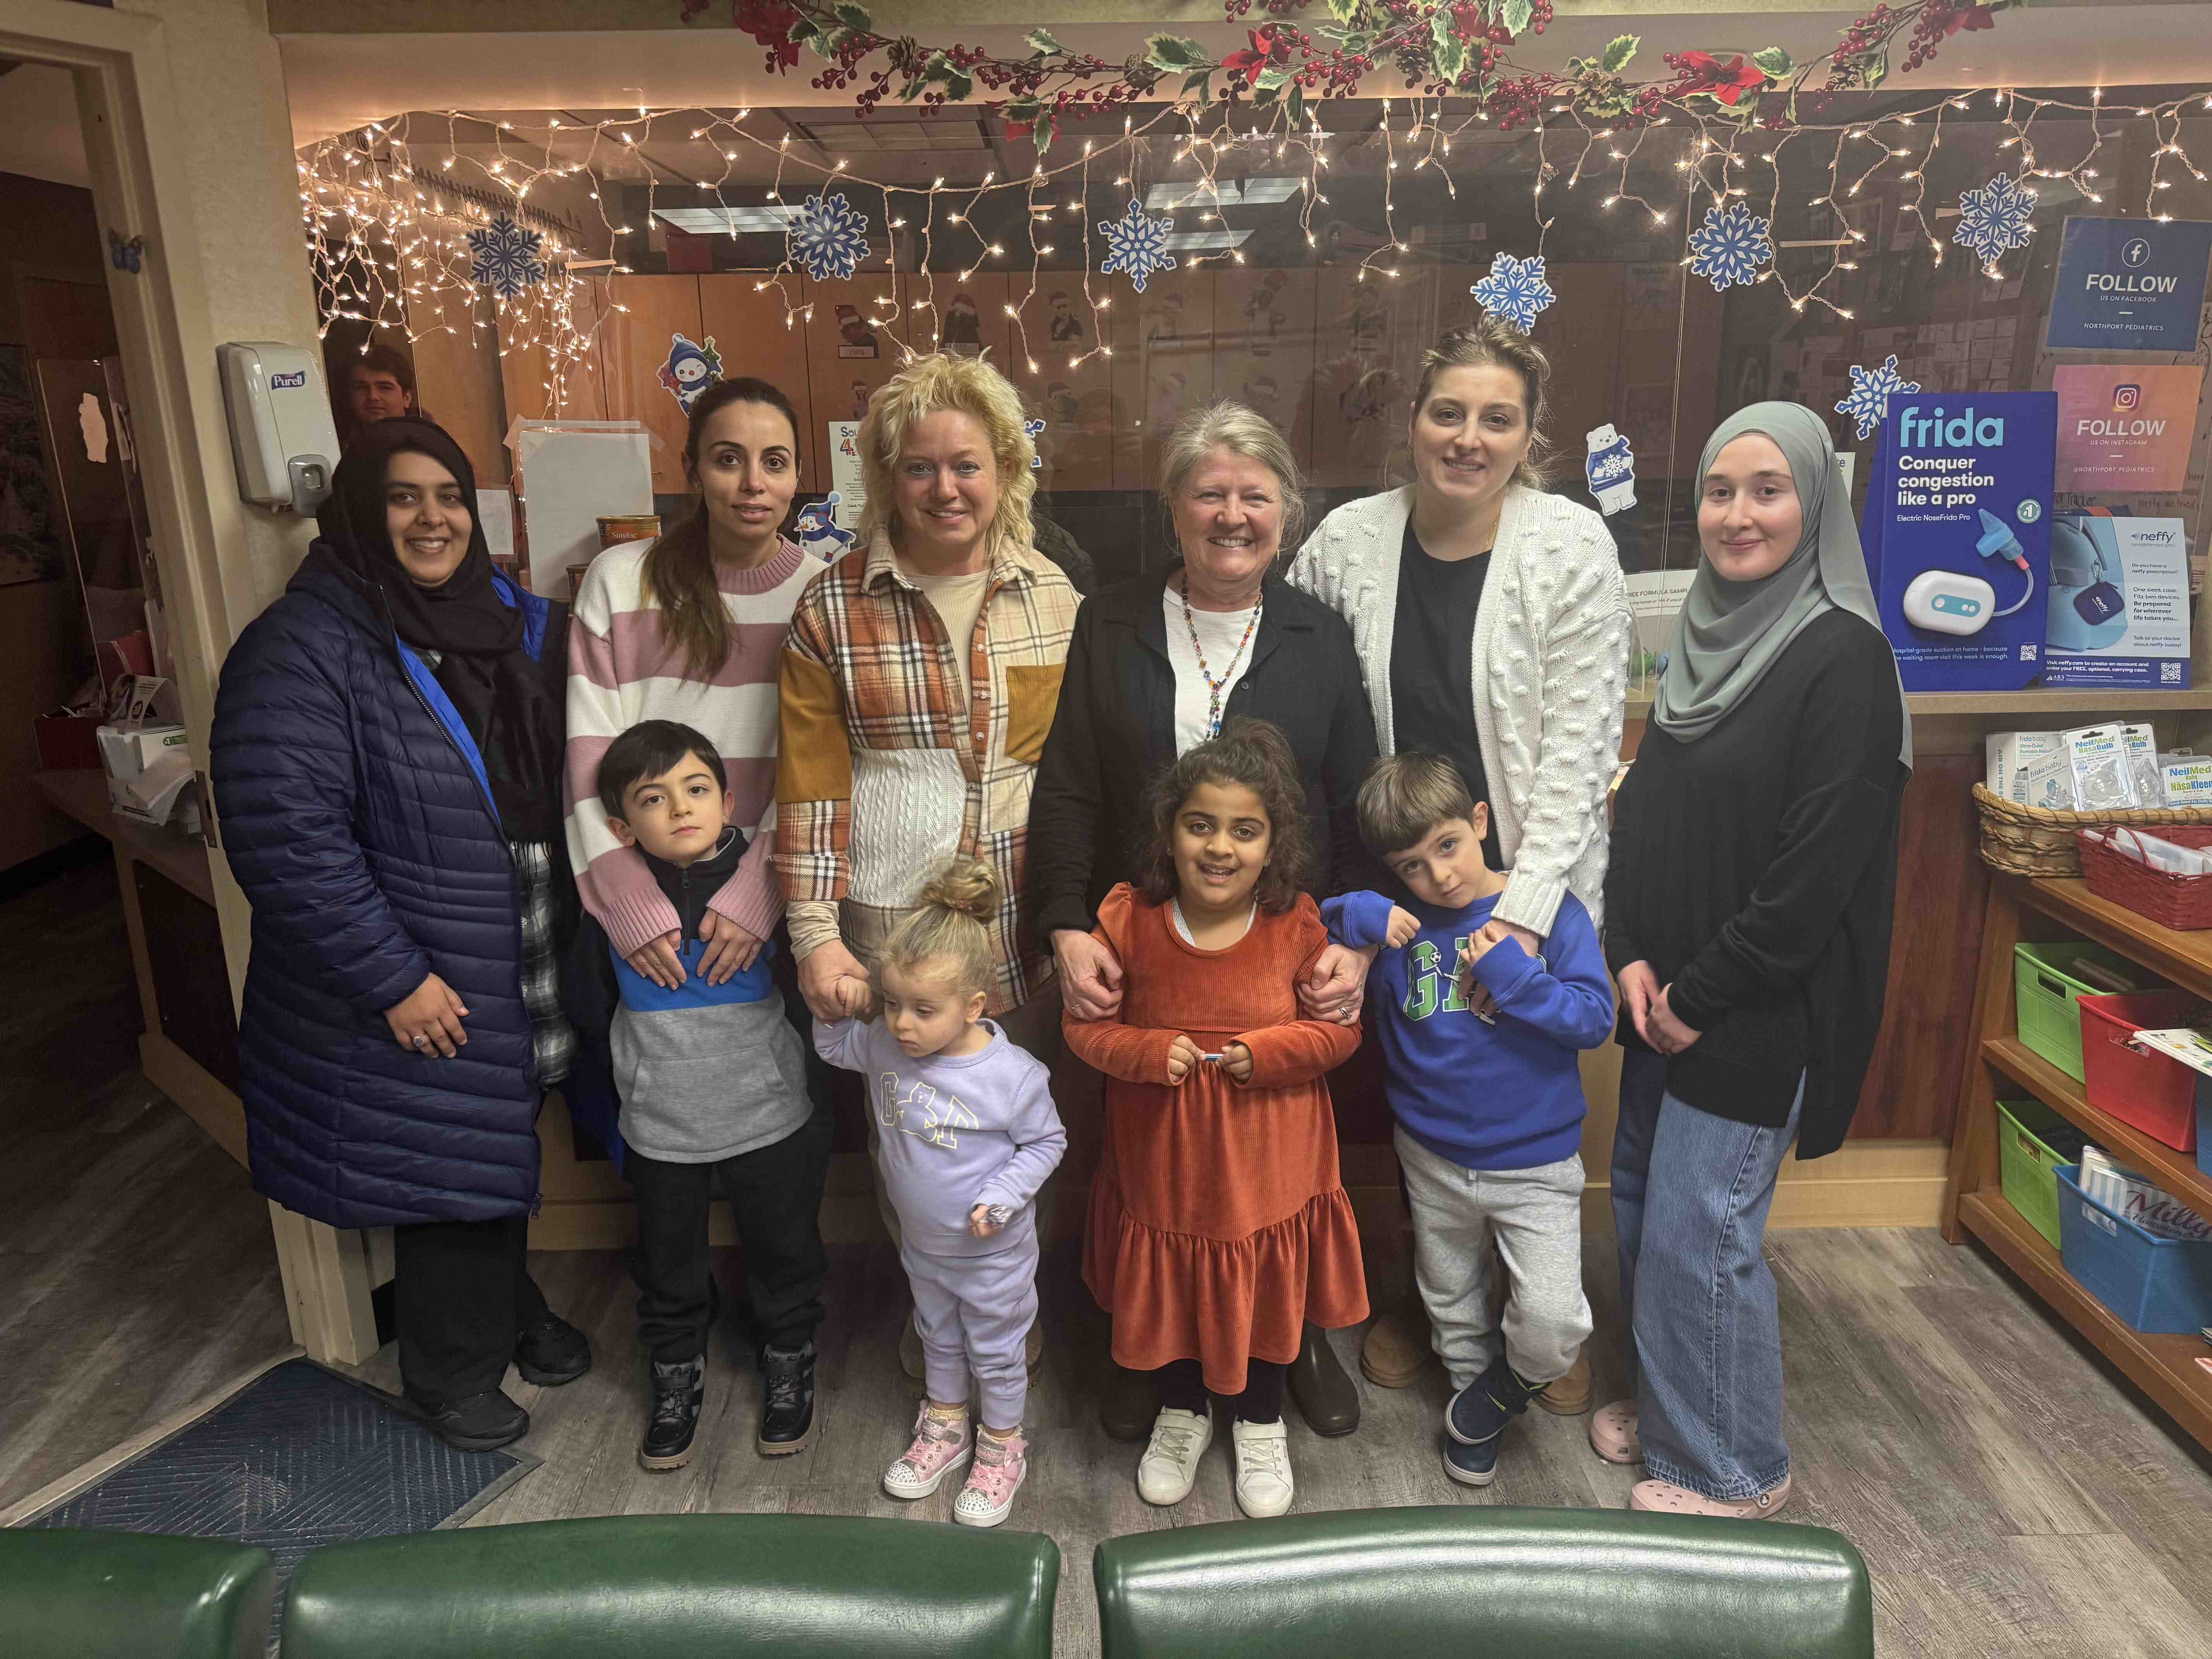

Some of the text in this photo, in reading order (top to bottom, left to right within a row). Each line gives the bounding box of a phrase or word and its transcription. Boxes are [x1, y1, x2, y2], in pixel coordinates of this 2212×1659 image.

[2086, 274, 2178, 292] FOLLOW
[273, 375, 302, 386] Purell
[1900, 407, 2004, 447] frida
[2077, 420, 2166, 436] FOLLOW
[1899, 455, 1976, 473] Conquer
[1898, 472, 1994, 491] congestion
[1898, 490, 1976, 508] like a pro
[2140, 531, 2174, 543] neffy
[2075, 736, 2115, 748] NeilMed
[2045, 760, 2061, 771] baby
[2169, 765, 2211, 776] NeilMed
